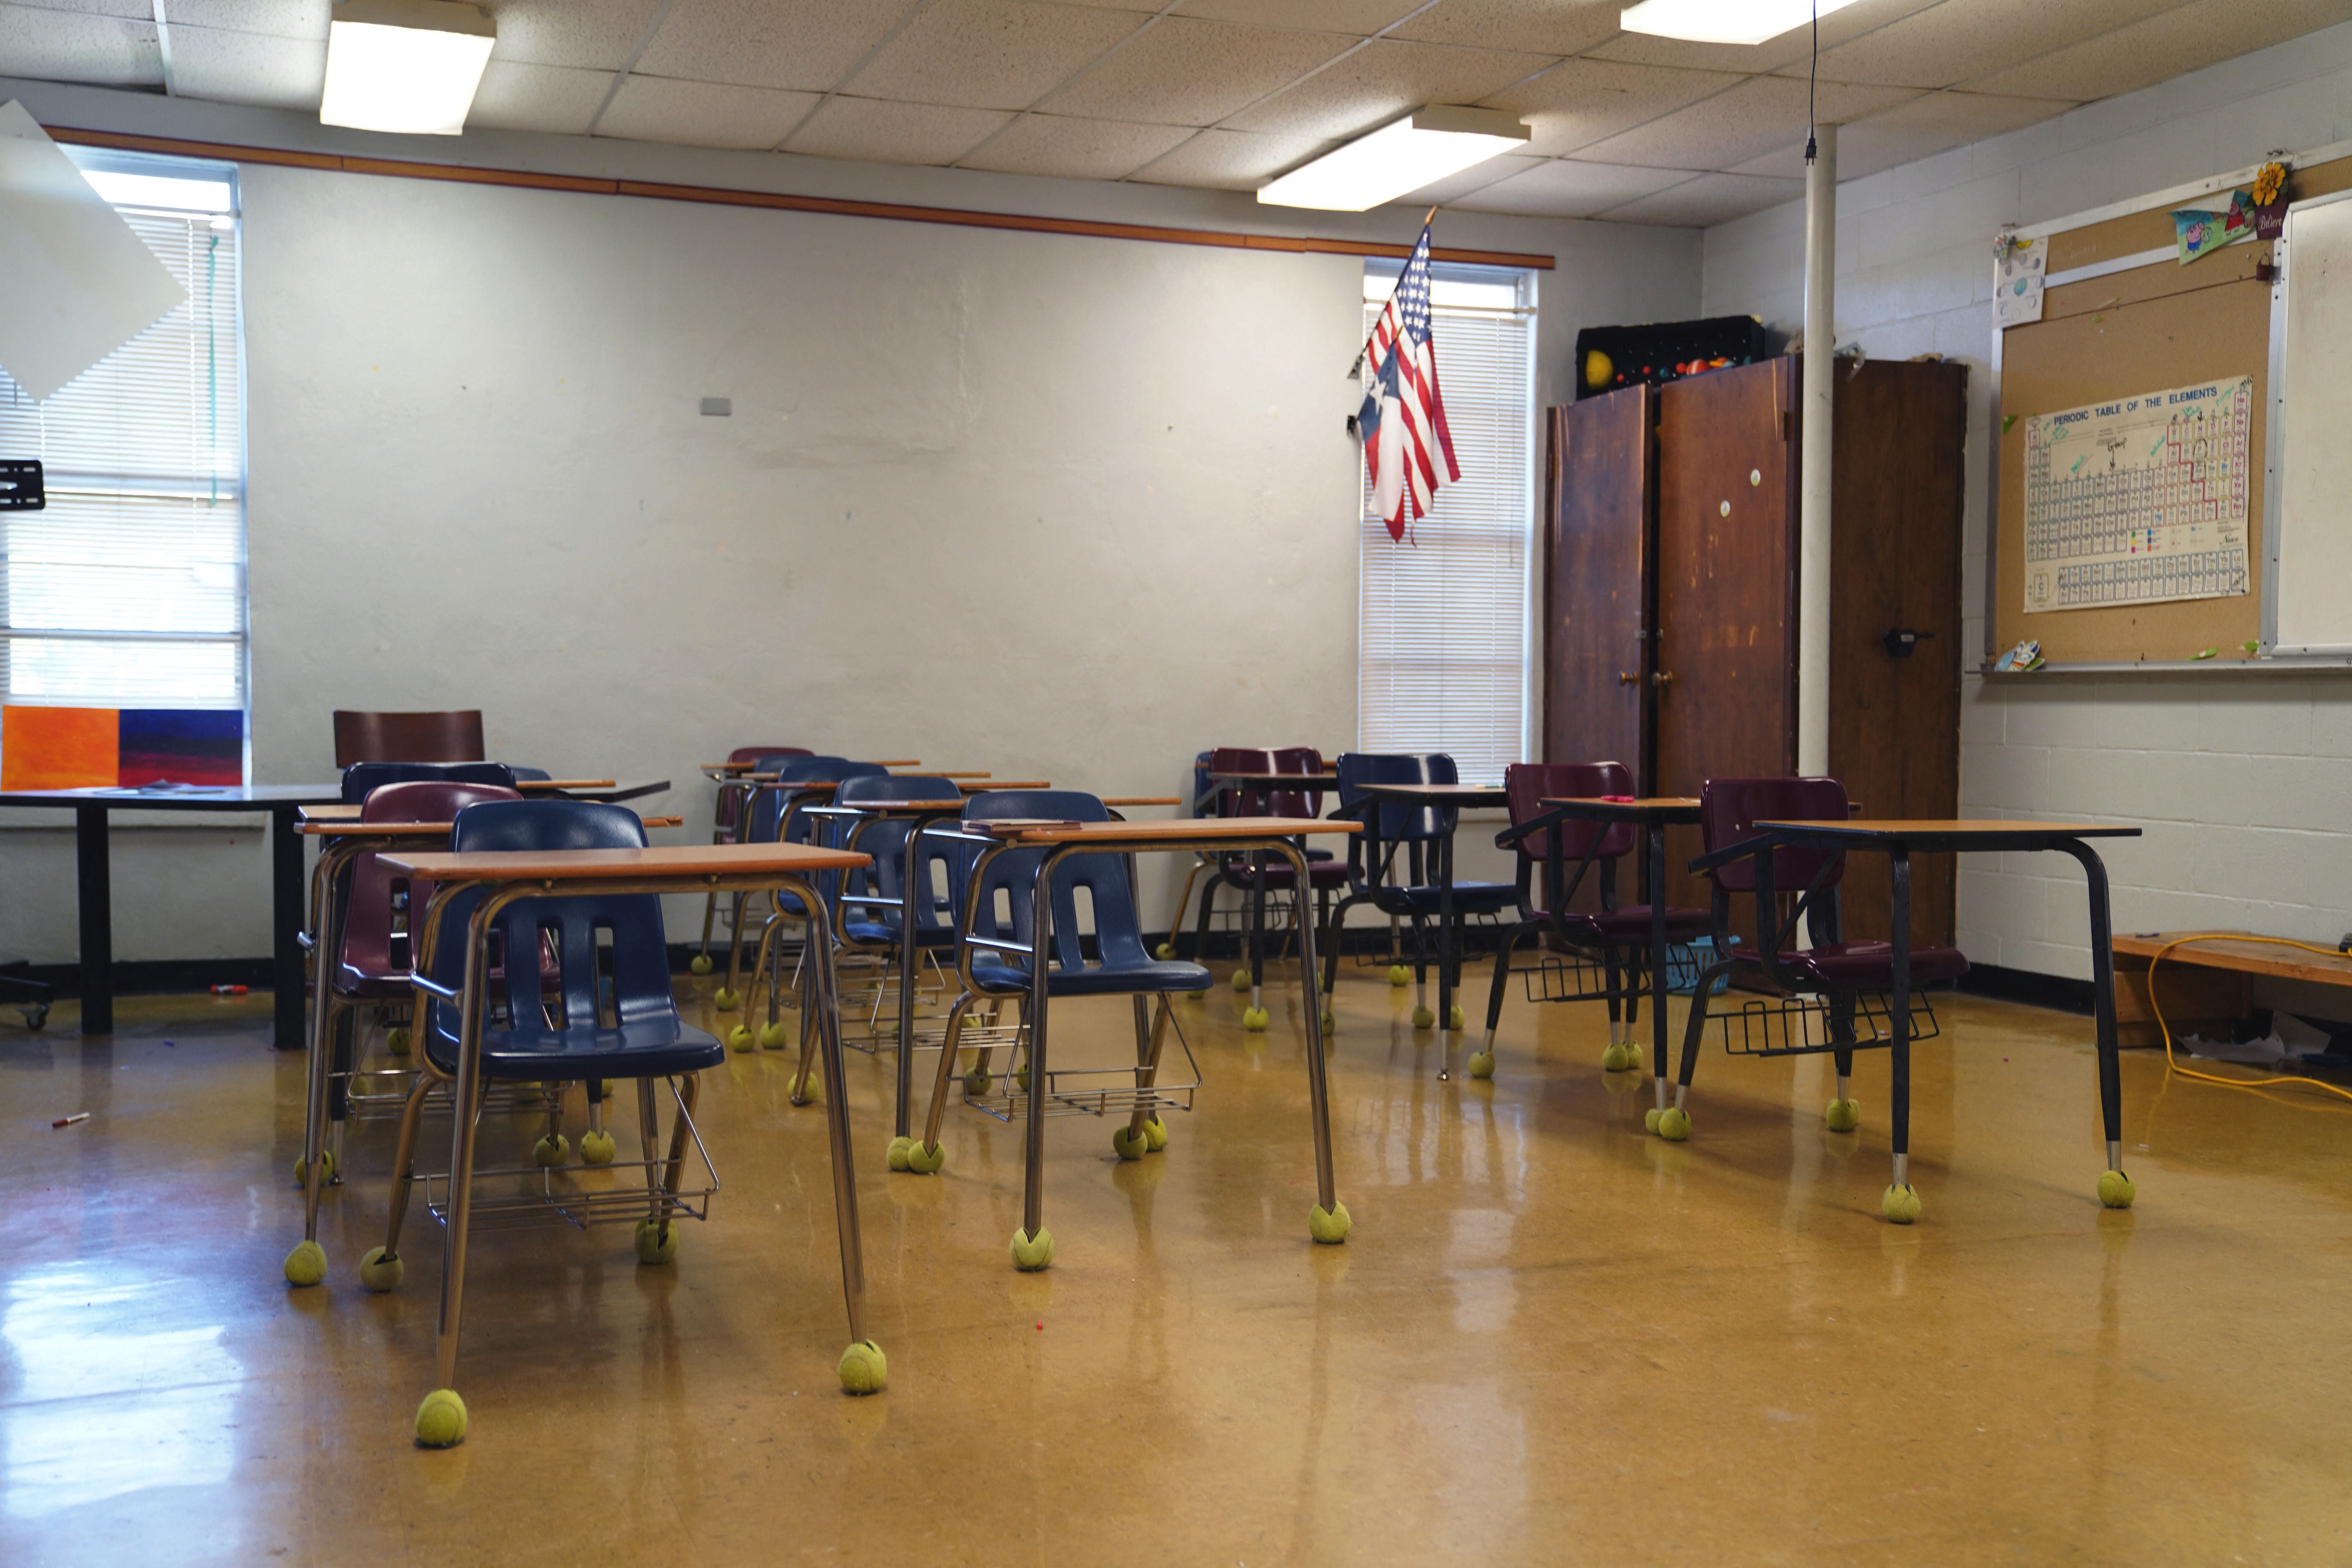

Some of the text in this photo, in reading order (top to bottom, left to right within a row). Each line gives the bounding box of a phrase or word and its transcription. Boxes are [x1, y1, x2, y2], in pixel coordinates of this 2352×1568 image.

[2258, 214, 2282, 230] Believe
[2054, 410, 2089, 425] PERIODIC
[2095, 404, 2121, 417] TABLE
[2127, 400, 2139, 412] OF
[2145, 397, 2161, 408] THE
[2169, 386, 2217, 404] ELEMENTS
